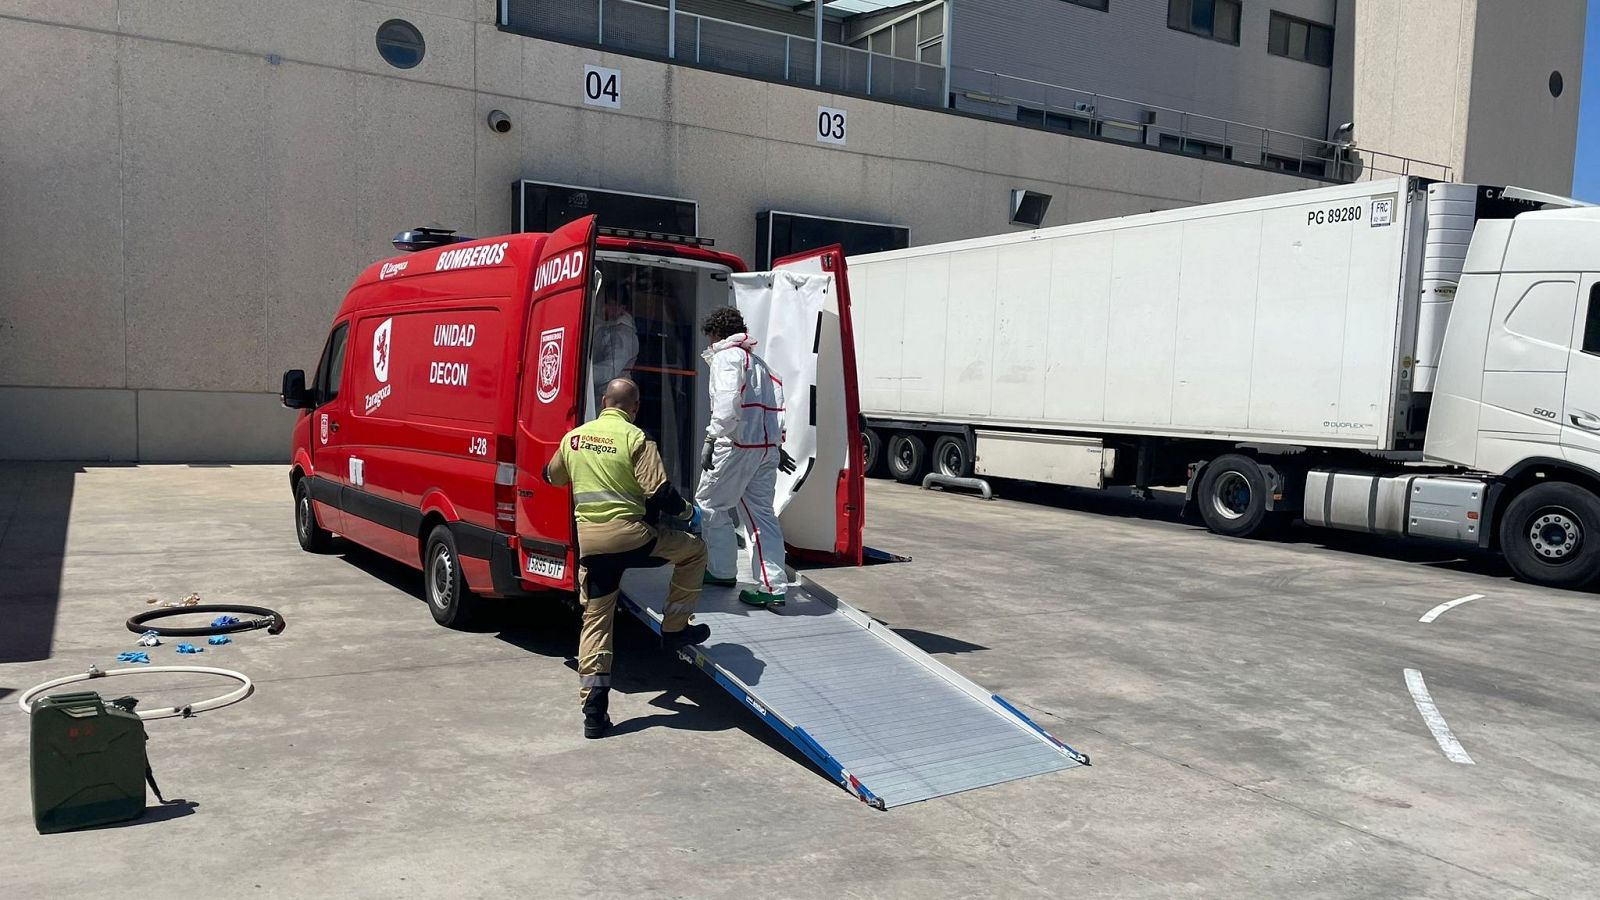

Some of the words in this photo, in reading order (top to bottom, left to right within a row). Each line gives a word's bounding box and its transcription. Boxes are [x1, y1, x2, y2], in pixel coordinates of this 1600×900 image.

[586, 71, 619, 102] 04
[819, 111, 845, 139] 03
[1307, 210, 1325, 226] PG
[1327, 205, 1362, 224] 89280
[1376, 202, 1389, 213] FRC
[435, 242, 509, 271] BOMBEROS
[534, 250, 583, 292] UNIDAD
[433, 324, 476, 347] UNIDAD
[429, 361, 469, 386] DECON
[365, 384, 391, 410] Zaragoza
[1533, 407, 1556, 419] 500
[469, 436, 487, 456] J-28
[580, 441, 617, 454] Zaragoza
[581, 435, 614, 445] BOMBEROS
